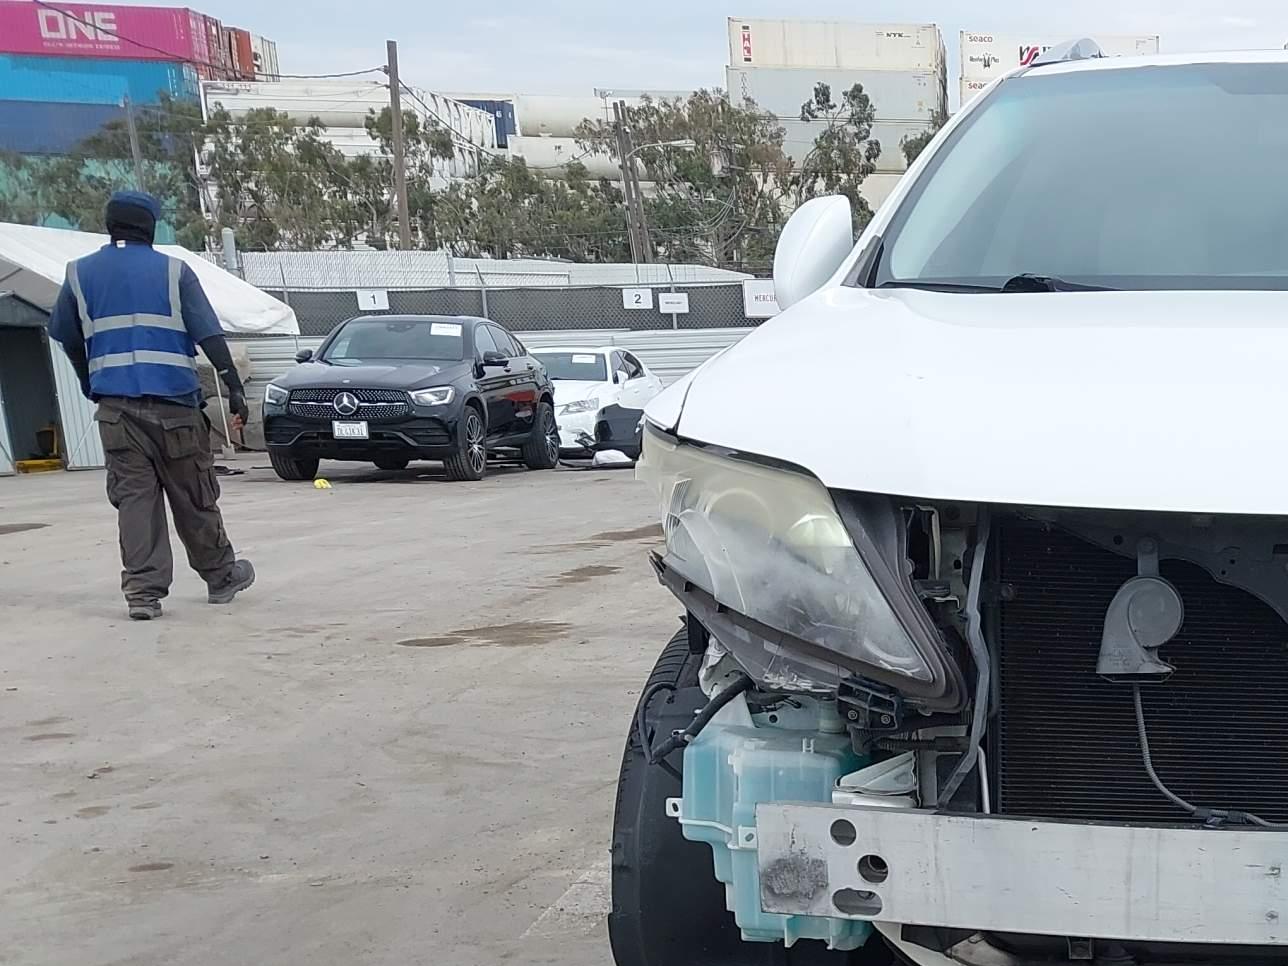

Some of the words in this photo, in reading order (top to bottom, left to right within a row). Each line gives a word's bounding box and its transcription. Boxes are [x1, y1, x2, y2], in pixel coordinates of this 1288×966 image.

[37, 9, 119, 42] ONE
[968, 35, 993, 43] seaco
[370, 294, 376, 305] 1
[634, 293, 642, 304] 2
